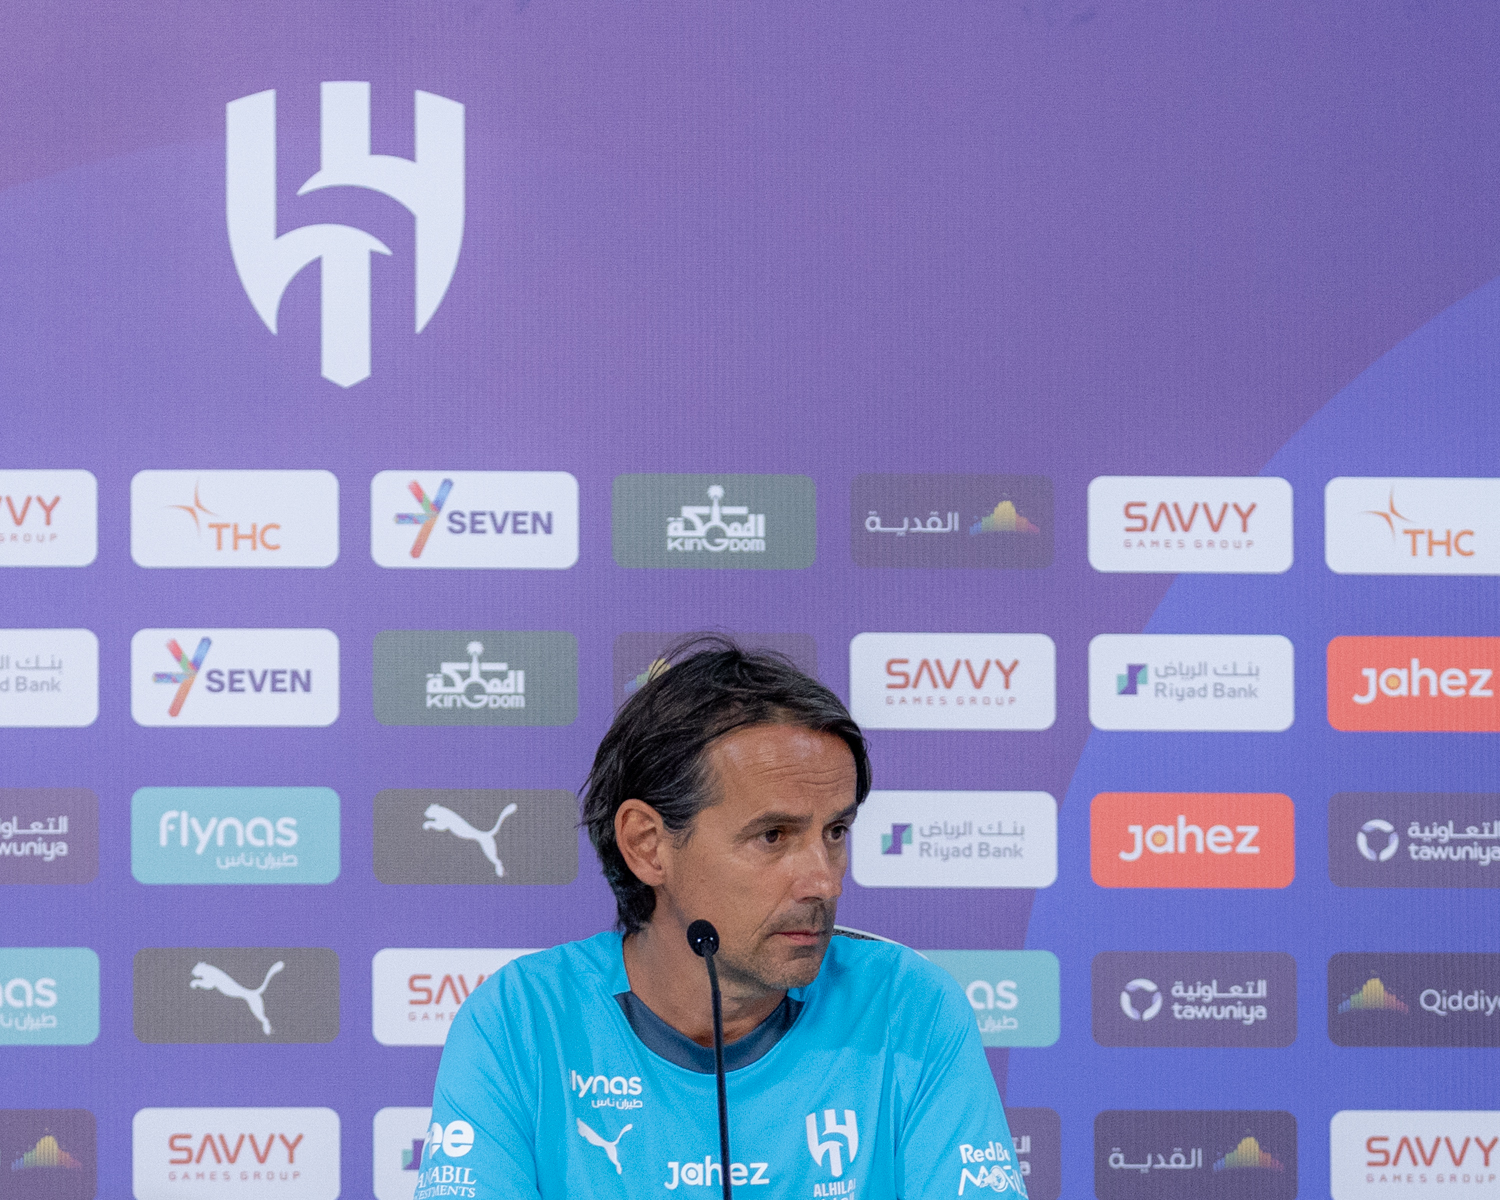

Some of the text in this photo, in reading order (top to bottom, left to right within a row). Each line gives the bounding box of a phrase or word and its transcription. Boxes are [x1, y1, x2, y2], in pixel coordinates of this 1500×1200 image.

[446, 510, 554, 535] SEVEN
[864, 511, 959, 537] القدية
[1123, 502, 1257, 533] SAVVY
[208, 523, 281, 551] THC
[1124, 539, 1255, 549] GAMES GROUP
[1402, 528, 1476, 557] THC
[15, 676, 61, 692] Bank
[206, 669, 312, 693] SEVEN
[885, 658, 1019, 690] SAVVY
[1352, 658, 1494, 705] jahez
[886, 696, 1017, 706] GAMES GROUP
[1154, 682, 1258, 702] Riyad Bank
[159, 810, 298, 855] flynas
[1118, 815, 1260, 861] jahez
[0, 836, 68, 862] wuniya
[920, 842, 1024, 861] Riyad Bank
[408, 973, 491, 1005] SAV
[408, 1011, 456, 1021] GAME
[1171, 1001, 1268, 1025] tawuniya
[571, 1069, 643, 1098] lynas
[168, 1133, 304, 1165] SAVVY
[1108, 1148, 1202, 1173] القدية
[1366, 1136, 1499, 1167] SAVVY
[168, 1171, 301, 1181] GAMES GROUP
[418, 1165, 477, 1188] ANABIL
[1366, 1173, 1497, 1184] GAMES GROUP
